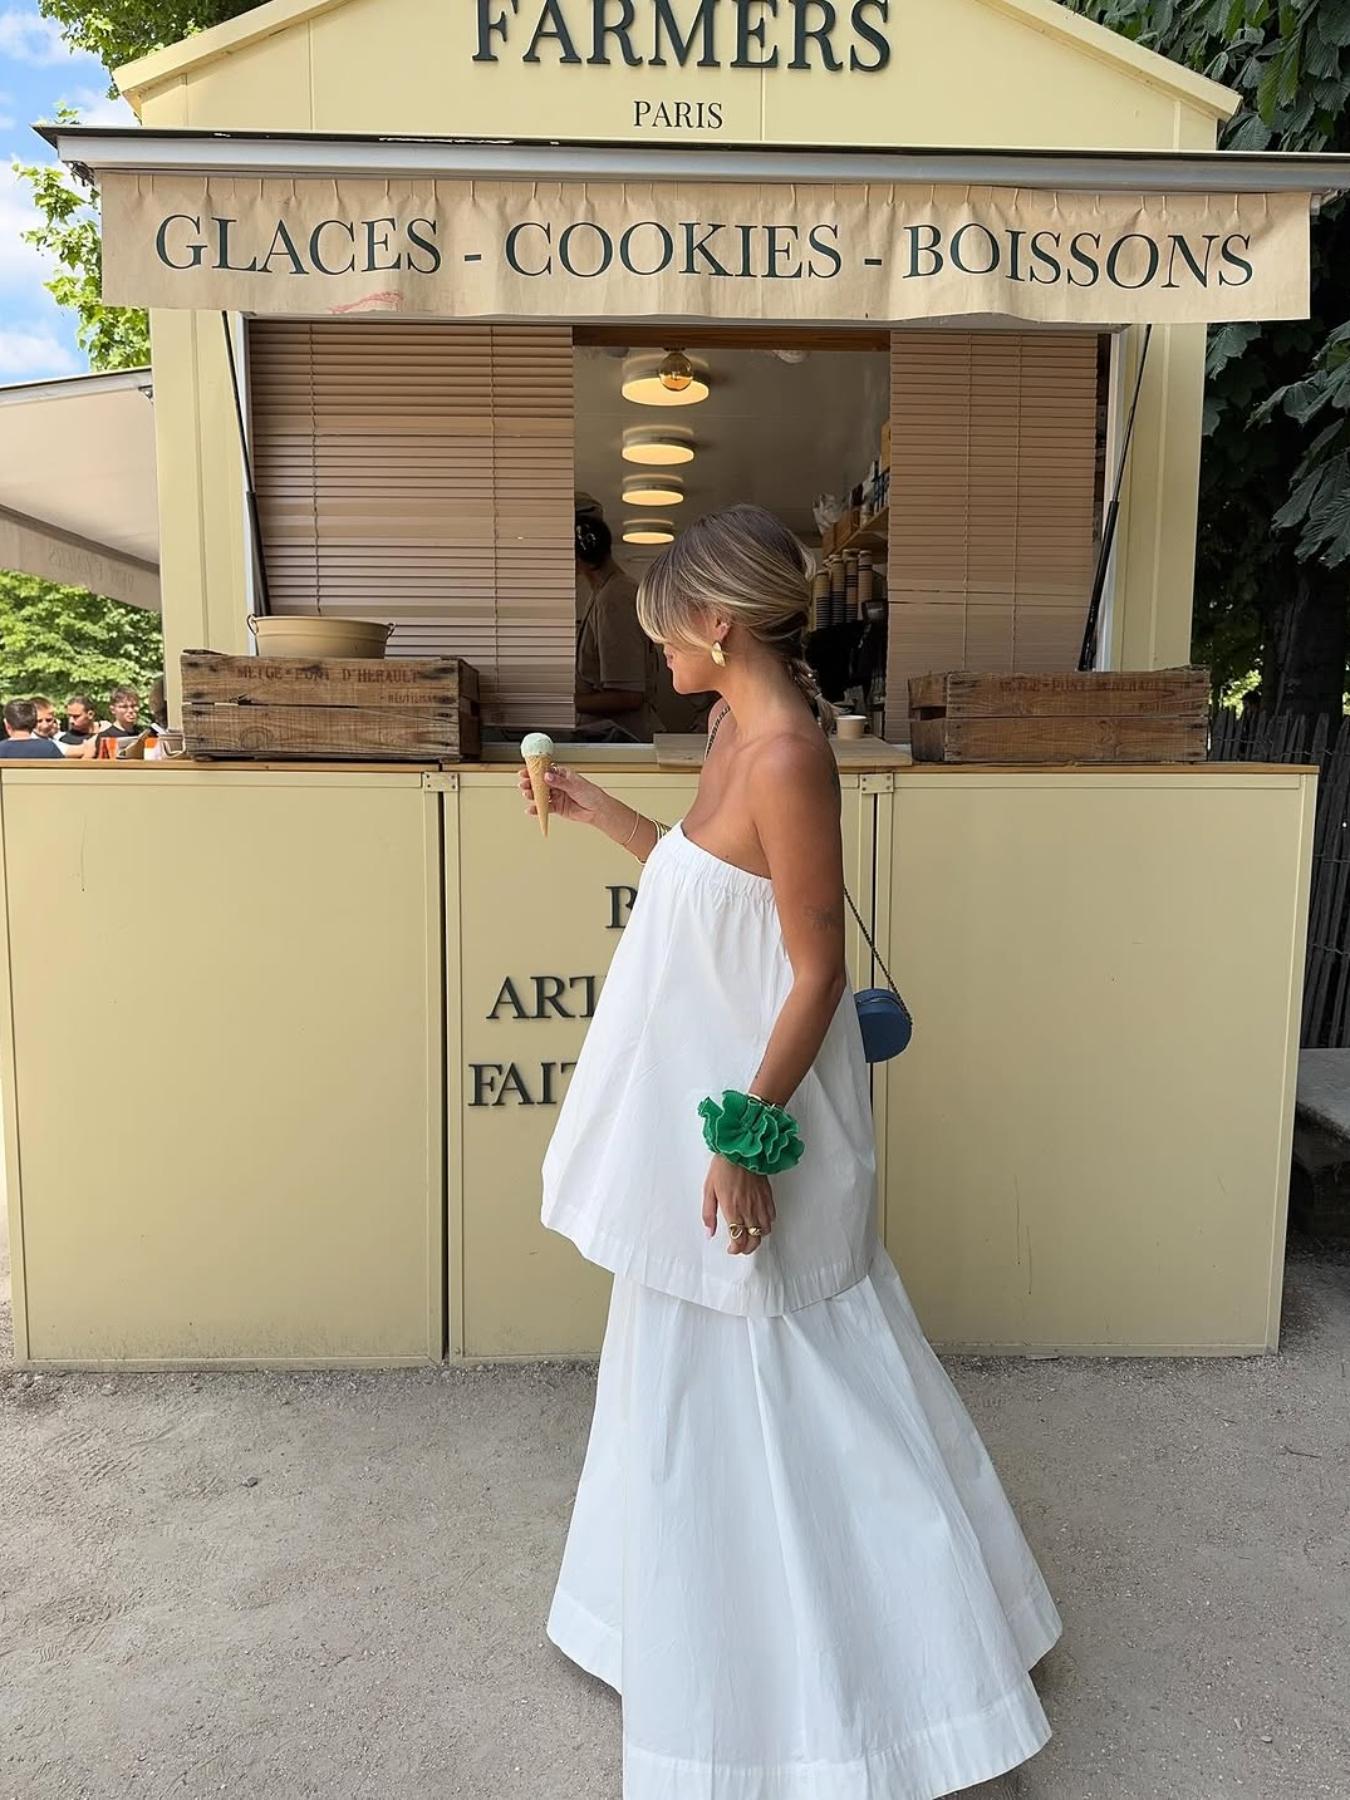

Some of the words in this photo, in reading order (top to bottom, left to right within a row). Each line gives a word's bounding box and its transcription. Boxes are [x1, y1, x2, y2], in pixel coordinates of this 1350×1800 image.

[472, 0, 892, 72] FARMERS
[633, 100, 723, 129] PARIS
[155, 214, 441, 276] GLACES
[505, 221, 842, 279] COOKIES
[902, 223, 1253, 289] BOISSONS
[467, 1062, 578, 1107] FAI
